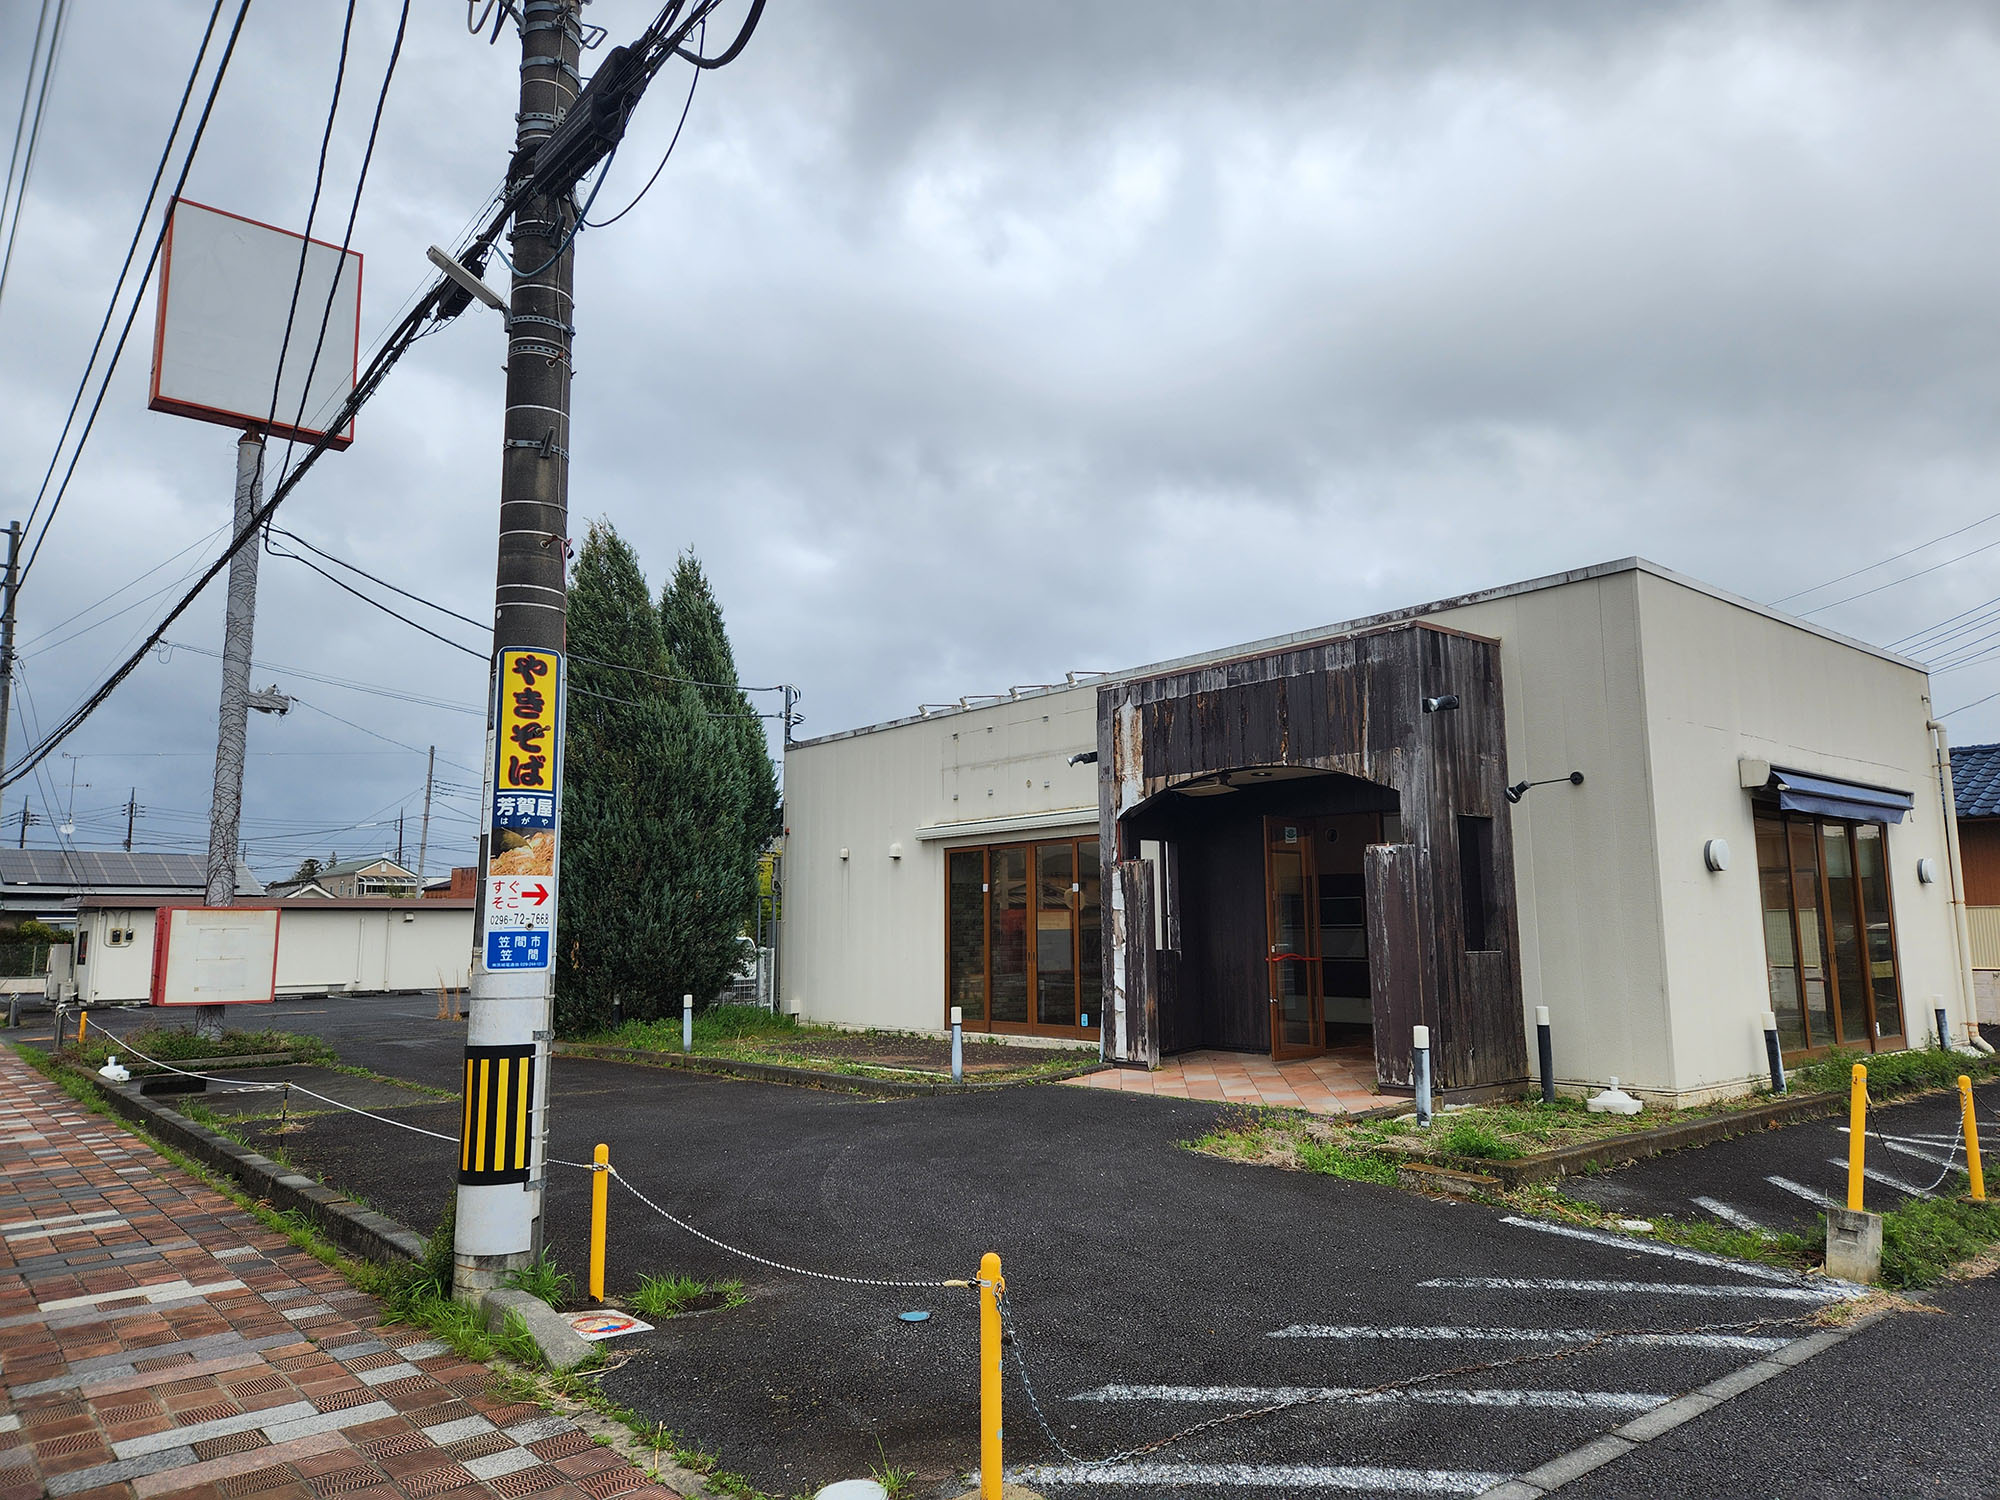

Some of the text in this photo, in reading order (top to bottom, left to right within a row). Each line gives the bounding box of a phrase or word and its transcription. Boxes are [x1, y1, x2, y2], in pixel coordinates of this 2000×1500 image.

[508, 654, 548, 787] やきそば
[497, 797, 552, 817] 芳賀屋
[500, 817, 549, 826] はがや
[492, 880, 520, 894] すぐ
[492, 896, 519, 910] そこ
[490, 912, 549, 925] 0296-72-7668
[498, 935, 541, 948] 笠間市
[500, 948, 539, 961] 笠間
